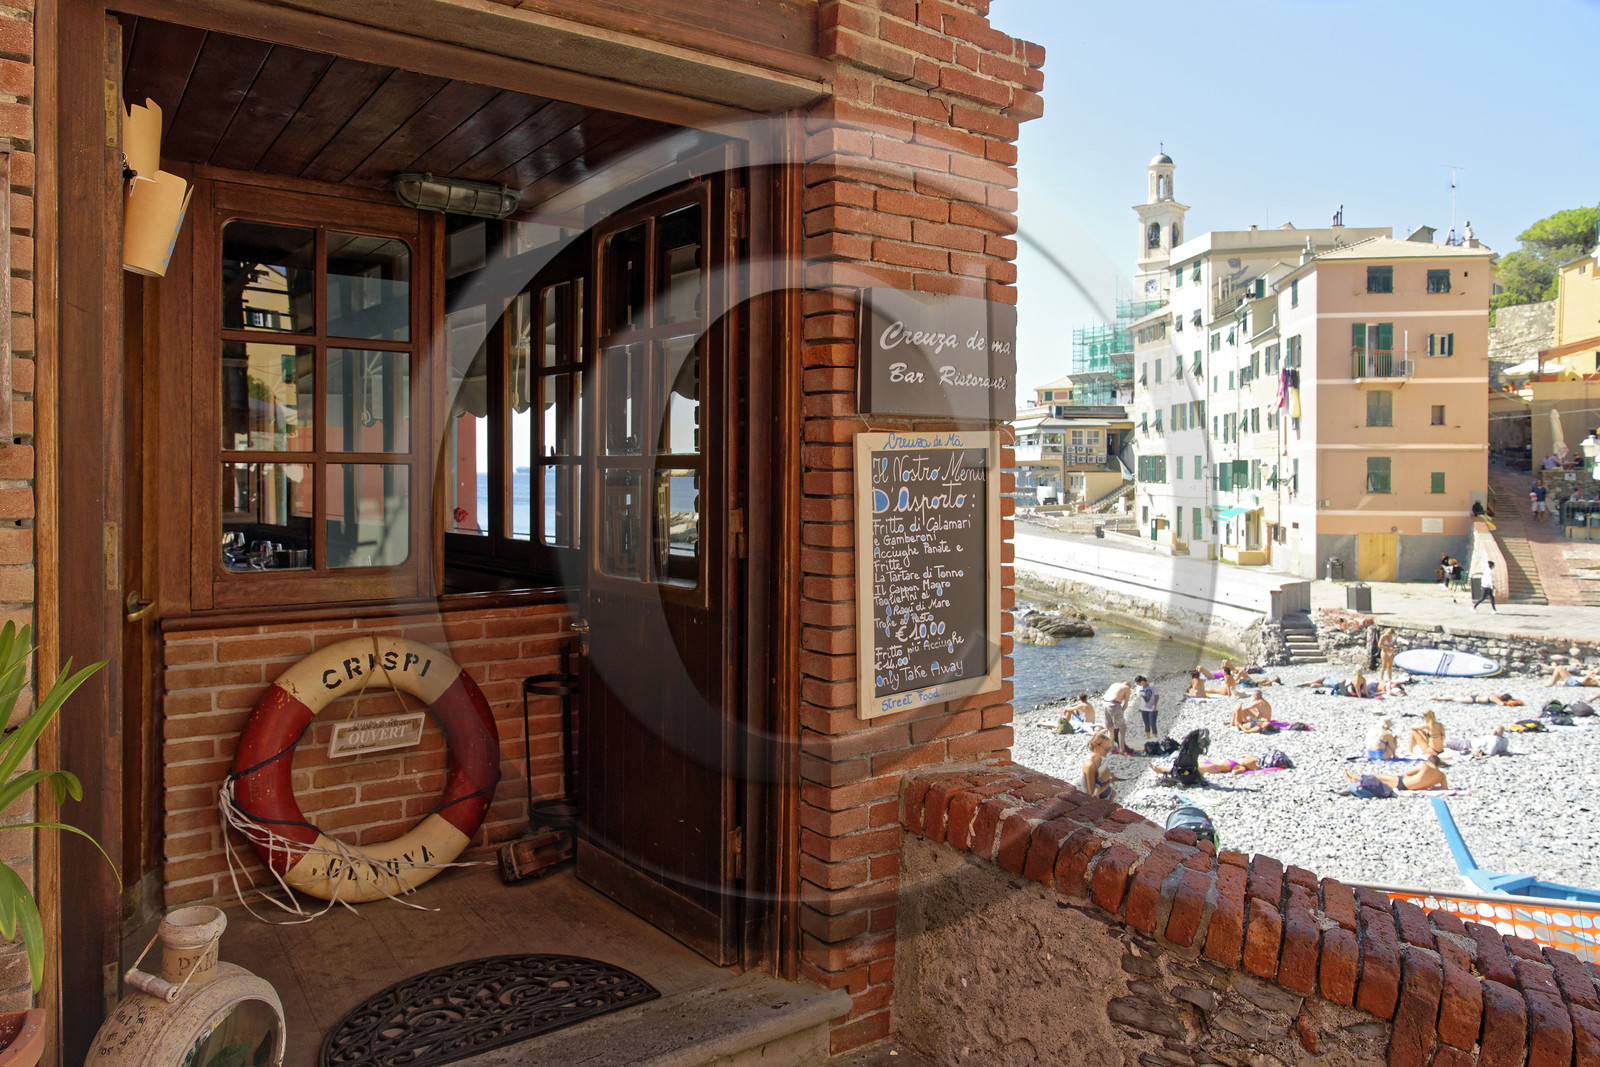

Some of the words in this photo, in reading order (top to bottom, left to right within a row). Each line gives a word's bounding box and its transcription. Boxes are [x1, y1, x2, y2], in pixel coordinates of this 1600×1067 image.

[880, 321, 960, 354] Creuza
[967, 330, 987, 350] de
[889, 362, 925, 383] Bar
[939, 366, 1007, 390] Ristorante
[883, 432, 931, 450] Creuza
[933, 435, 943, 446] de
[873, 457, 888, 483] Il
[893, 455, 941, 482] Nostro
[873, 516, 904, 535] Fritto
[910, 516, 921, 531] di
[926, 514, 971, 532] Calamari
[874, 538, 880, 546] e
[883, 531, 937, 546] Gamberoni
[874, 544, 919, 567] Acciughe
[923, 540, 951, 553] Panate
[956, 544, 964, 552] e
[873, 558, 902, 572] Fritte
[875, 573, 885, 583] La
[886, 570, 920, 582] Tartare
[923, 566, 932, 578] di
[934, 565, 964, 578] Tonno
[875, 585, 886, 596] Il
[889, 583, 920, 596] Cappon
[923, 579, 951, 597] Magro
[922, 590, 930, 599] al
[916, 601, 926, 611] di
[928, 598, 950, 609] Mare
[874, 616, 897, 637] Trofie
[911, 612, 934, 624] Pesto
[875, 645, 902, 661] Fritto
[924, 631, 965, 654] Acciughe
[322, 652, 431, 689] CRISPI
[900, 665, 927, 681] Take
[931, 661, 964, 677] Away
[882, 693, 912, 711] Street
[348, 726, 407, 745] OUVERT
